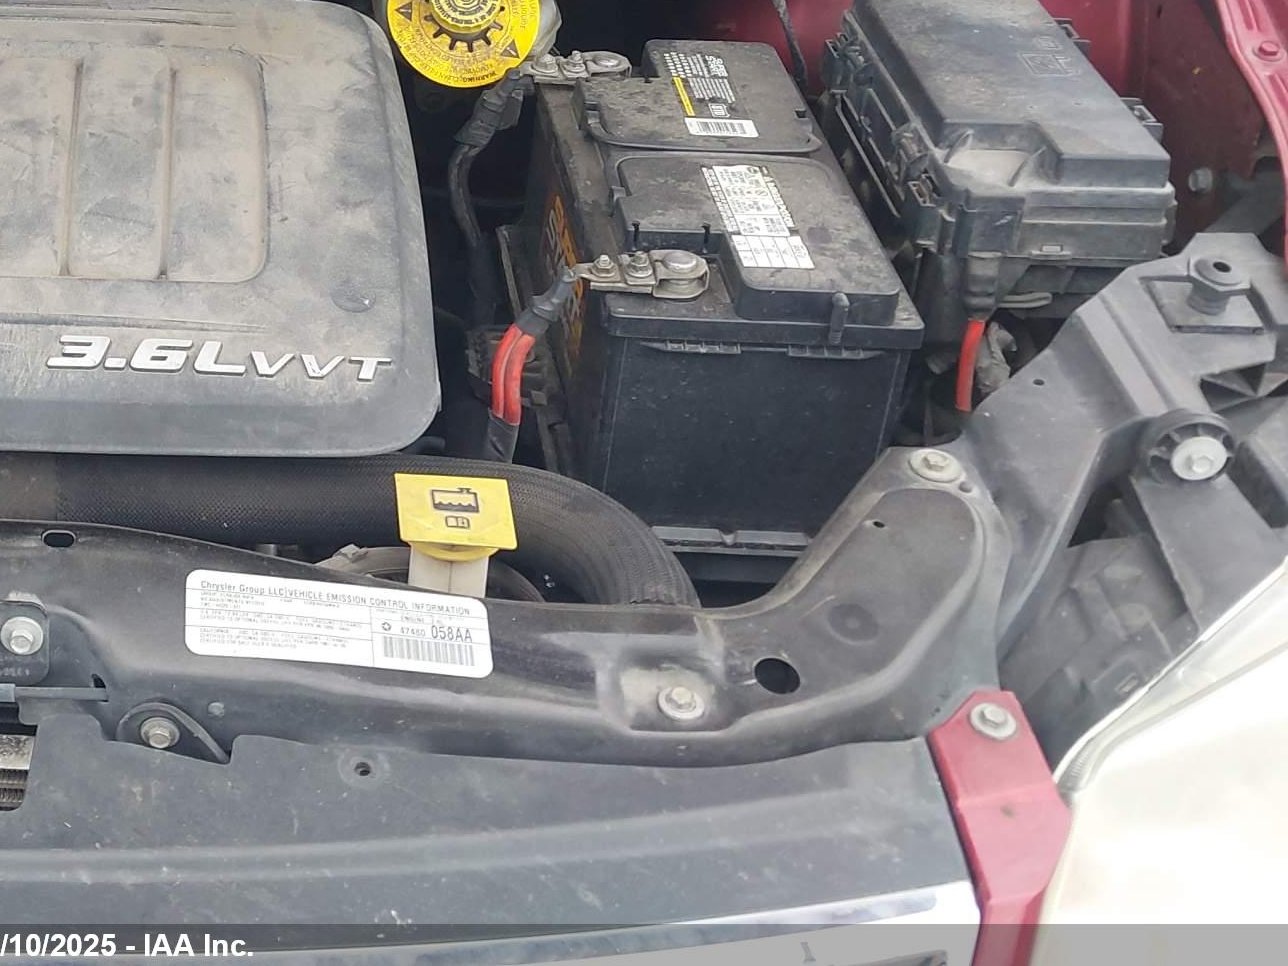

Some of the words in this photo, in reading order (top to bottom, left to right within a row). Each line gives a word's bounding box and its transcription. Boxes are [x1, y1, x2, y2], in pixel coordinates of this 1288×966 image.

[200, 580, 235, 591] Chrysler
[239, 584, 265, 595] Group
[326, 593, 366, 604] EMISSION
[370, 597, 408, 609] CONTROL
[411, 602, 470, 616] INFORMATION
[431, 624, 473, 643] 058AA
